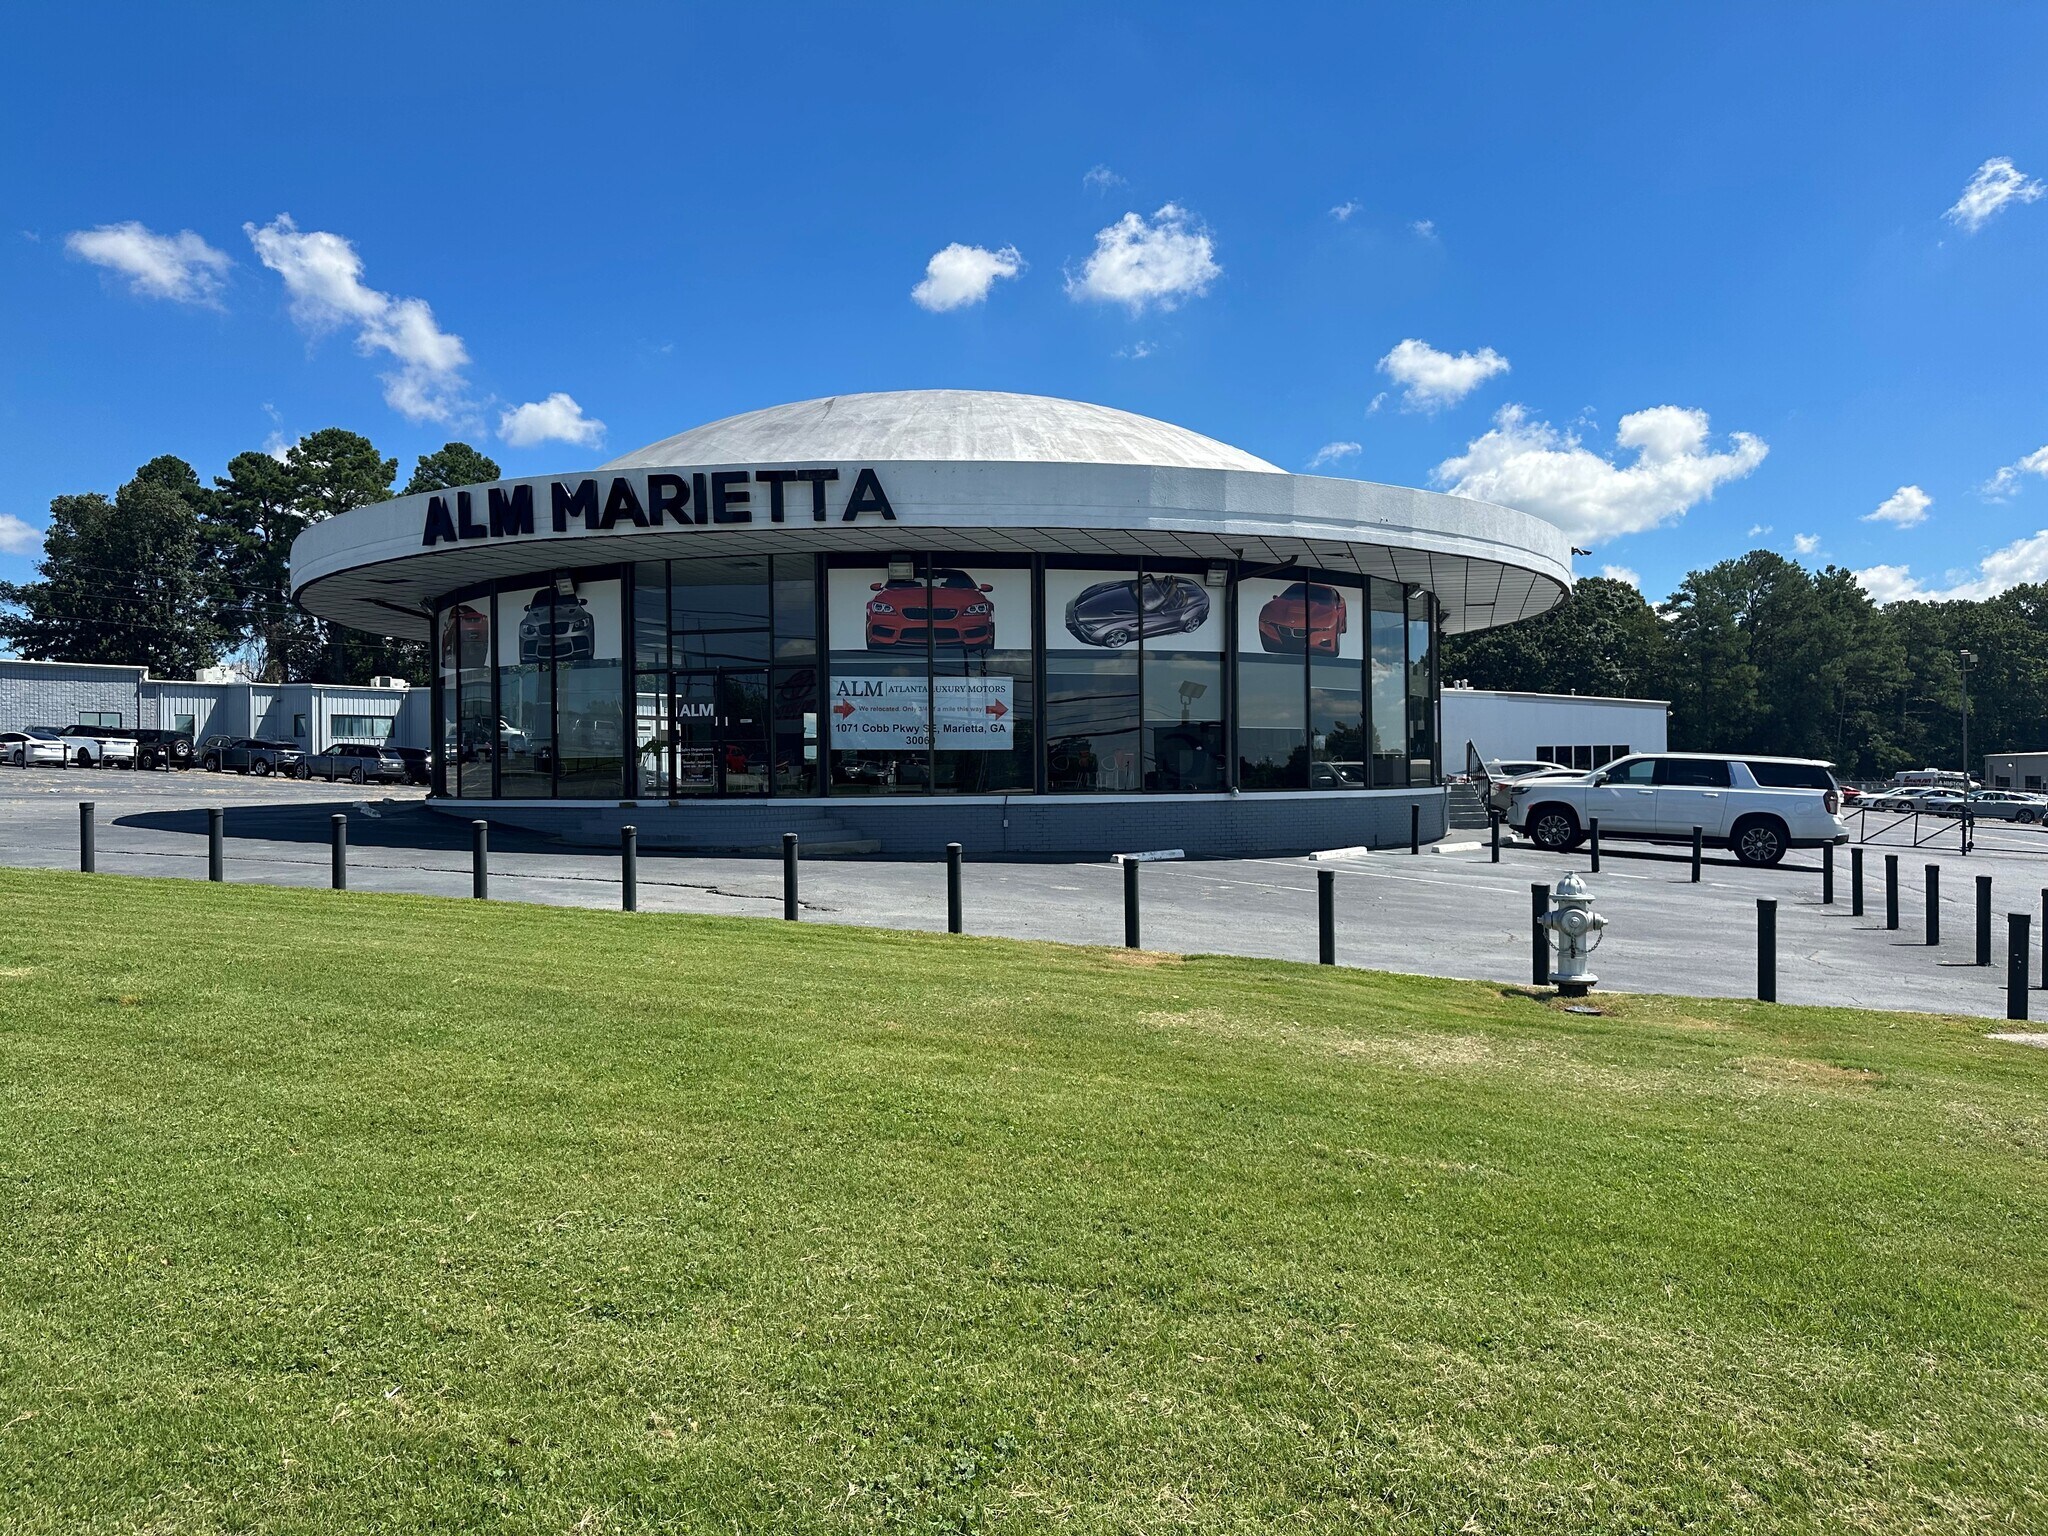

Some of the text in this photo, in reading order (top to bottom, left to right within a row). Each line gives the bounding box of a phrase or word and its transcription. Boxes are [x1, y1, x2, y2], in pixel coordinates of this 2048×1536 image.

[422, 468, 897, 546] ALM MARIETTA
[836, 681, 883, 697] ALM
[679, 703, 714, 717] ALM
[835, 724, 859, 733] 1071
[862, 724, 890, 733] Cobb
[892, 724, 920, 735] Pkwy
[943, 724, 987, 735] Marietta,
[990, 724, 1006, 733] GA
